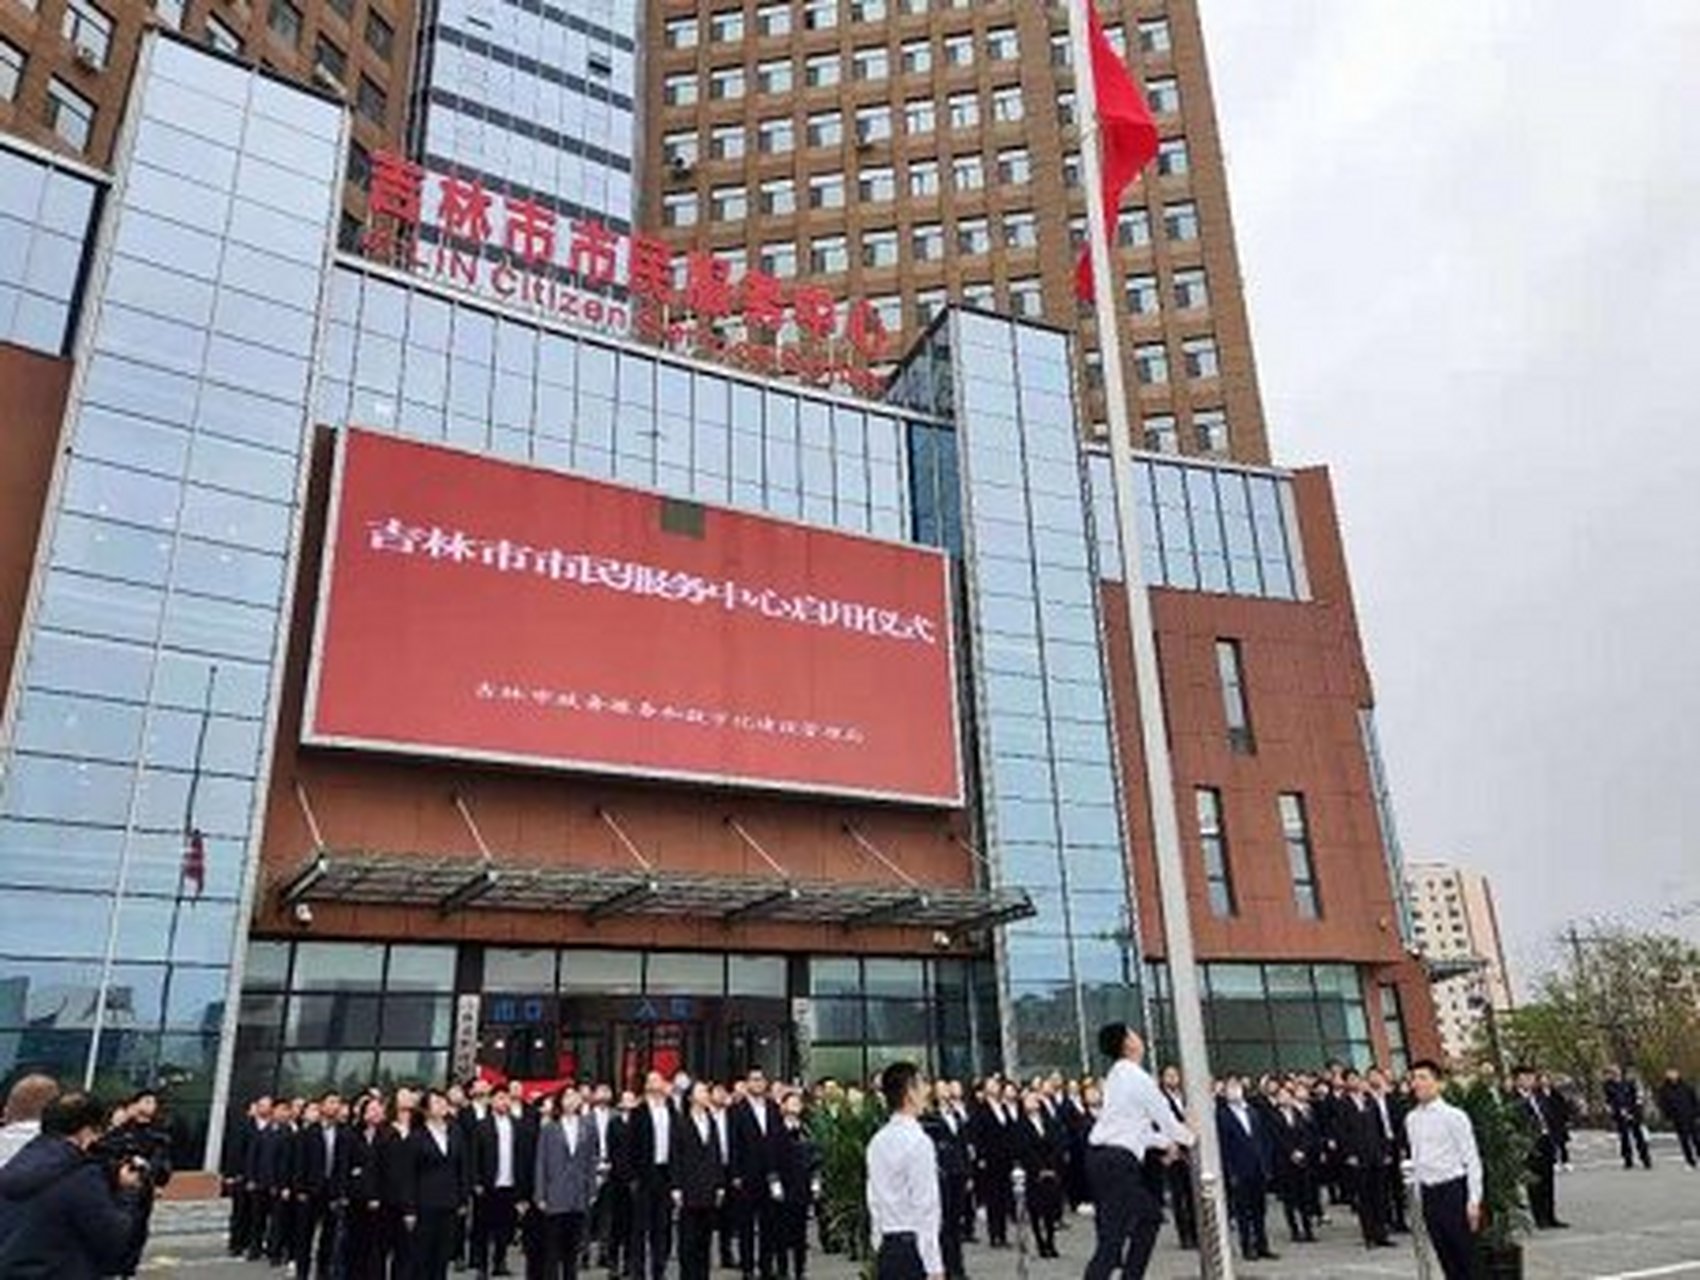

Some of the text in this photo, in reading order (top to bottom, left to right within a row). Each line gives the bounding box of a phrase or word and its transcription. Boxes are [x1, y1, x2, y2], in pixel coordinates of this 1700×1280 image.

[367, 147, 889, 358] 吉林市市民服务中心
[491, 262, 628, 330] Citizen
